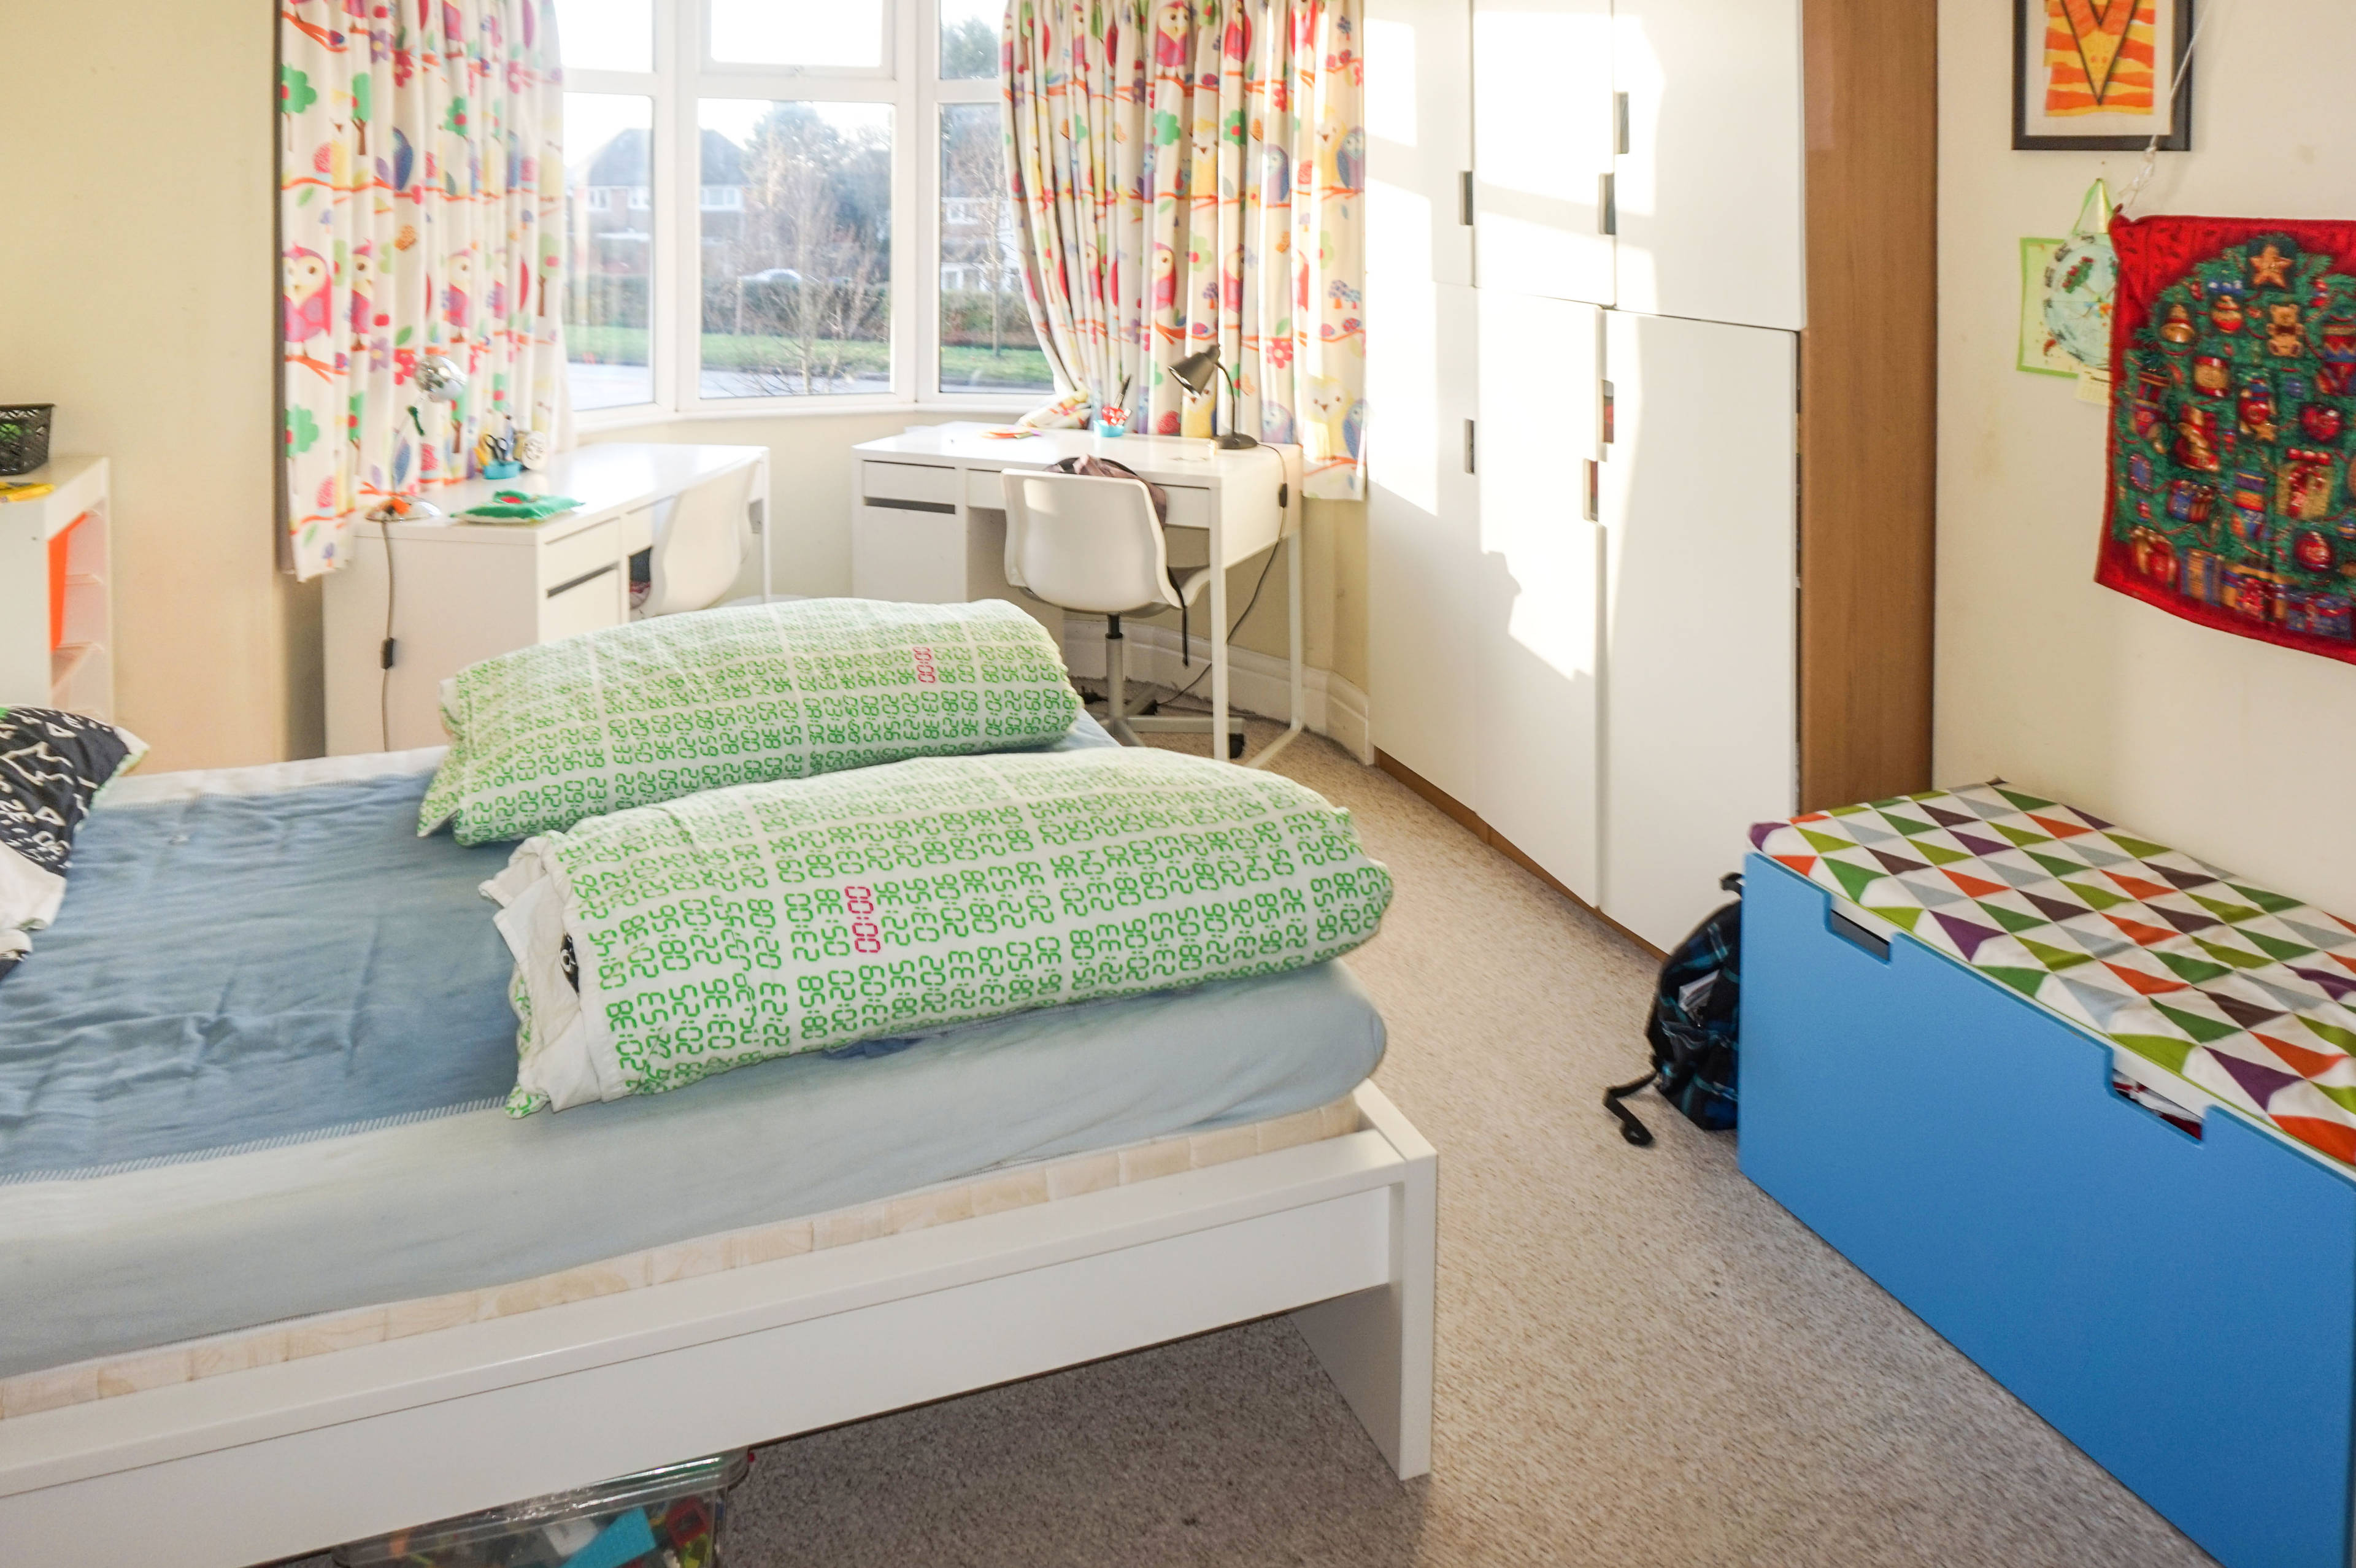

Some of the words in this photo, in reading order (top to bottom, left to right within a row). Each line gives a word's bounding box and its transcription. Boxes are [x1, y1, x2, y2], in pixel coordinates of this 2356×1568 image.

[727, 664, 751, 698] 08:30
[748, 661, 770, 695] 23:04
[795, 656, 817, 692] 20:39
[855, 654, 876, 687] 20:06
[875, 653, 896, 686] 03:56
[895, 650, 916, 685] 22:36
[914, 647, 935, 683] 00:00
[934, 647, 956, 683] 05:38
[954, 647, 975, 683] 23:00
[979, 646, 999, 683] 02:08
[1016, 645, 1038, 682] 20:23
[695, 710, 718, 756] 08:59
[715, 708, 739, 755] 05:28
[737, 705, 760, 752] 22:00
[757, 702, 780, 749] 05:38
[780, 700, 802, 745] 20:55
[823, 697, 845, 744] 23:38
[861, 695, 881, 742] 08:25
[882, 694, 901, 741] 20:56
[901, 693, 920, 740] 20:23
[921, 691, 939, 739] 03:38
[941, 691, 959, 738] 08:29
[961, 690, 978, 736] 09:36
[985, 690, 1003, 736] 20:30
[1004, 690, 1023, 736] 22:06
[1023, 690, 1042, 734] 09:58
[1043, 688, 1060, 731] 06:05
[537, 734, 560, 775] 23:22
[561, 728, 582, 771] 22:56
[583, 726, 605, 767] 09:39
[609, 720, 633, 764] 02:33
[631, 718, 653, 763] 20:50
[651, 715, 675, 760] 09:36
[672, 713, 697, 759] 20:20
[940, 812, 978, 860] 09:08
[967, 809, 1006, 856] 23:38
[995, 806, 1033, 851] 08:06
[1028, 802, 1067, 845] 20:55
[1054, 798, 1093, 841] 05:38
[1079, 794, 1118, 836] 22:00
[1106, 792, 1144, 832] 05:28
[1307, 810, 1348, 861] 09:45
[733, 844, 768, 888] 20:30
[769, 837, 805, 882] 09:36
[798, 830, 834, 878] 08:29
[828, 828, 864, 874] 03:38
[858, 824, 893, 870] 20:23
[885, 821, 922, 867] 20:56
[912, 817, 950, 864] 08:25
[1155, 836, 1193, 894] 22:53
[1180, 832, 1219, 890] 08:20
[1206, 831, 1245, 886] 20:38
[1232, 827, 1270, 882] 04:03
[1253, 822, 1295, 875] 05:28
[1285, 815, 1325, 866] 22:33
[631, 859, 669, 898] 02:03
[1016, 862, 1054, 923] 20:39
[1050, 855, 1088, 916] 20:36
[1079, 850, 1114, 911] 23:04
[1103, 845, 1141, 905] 08:30
[1129, 840, 1168, 899] 09:00
[815, 888, 850, 956] 05:38
[845, 886, 880, 953] 00:00
[874, 882, 910, 946] 22:36
[903, 878, 940, 942] 03:56
[931, 874, 969, 937] 20:06
[960, 870, 998, 934] 08:38
[988, 866, 1026, 928] 22:53
[1280, 887, 1307, 948] 22:32
[1311, 878, 1337, 941] 06:59
[1333, 872, 1360, 934] 20:38
[1357, 867, 1381, 929] 02:53
[620, 915, 659, 978] 20:38
[649, 905, 691, 970] 08:56
[679, 899, 722, 964] 22:00
[747, 899, 782, 969] 02:08
[784, 893, 820, 961] 23:00
[1149, 912, 1175, 975] 23:53
[1175, 907, 1202, 970] 08:05
[1202, 904, 1230, 964] 22:06
[1228, 899, 1256, 958] 23:26
[1255, 893, 1282, 953] 06:58
[589, 930, 626, 990] 09:45
[1006, 941, 1034, 1001] 08:50
[1036, 937, 1061, 993] 06:30
[1070, 929, 1096, 989] 05:08
[1096, 924, 1123, 984] 22:33
[1122, 919, 1149, 980] 20:06
[828, 969, 857, 1031] 20:20
[859, 965, 888, 1026] 23:09
[888, 961, 917, 1017] 08:35
[919, 955, 946, 1013] 20:02
[948, 950, 976, 1009] 22:33
[977, 946, 1005, 1005] 23:29
[669, 985, 703, 1054] 20:25
[701, 979, 735, 1049] 03:36
[760, 982, 789, 1046] 22:23
[798, 975, 827, 1038] 08:58
[606, 1000, 644, 1071] 20:38
